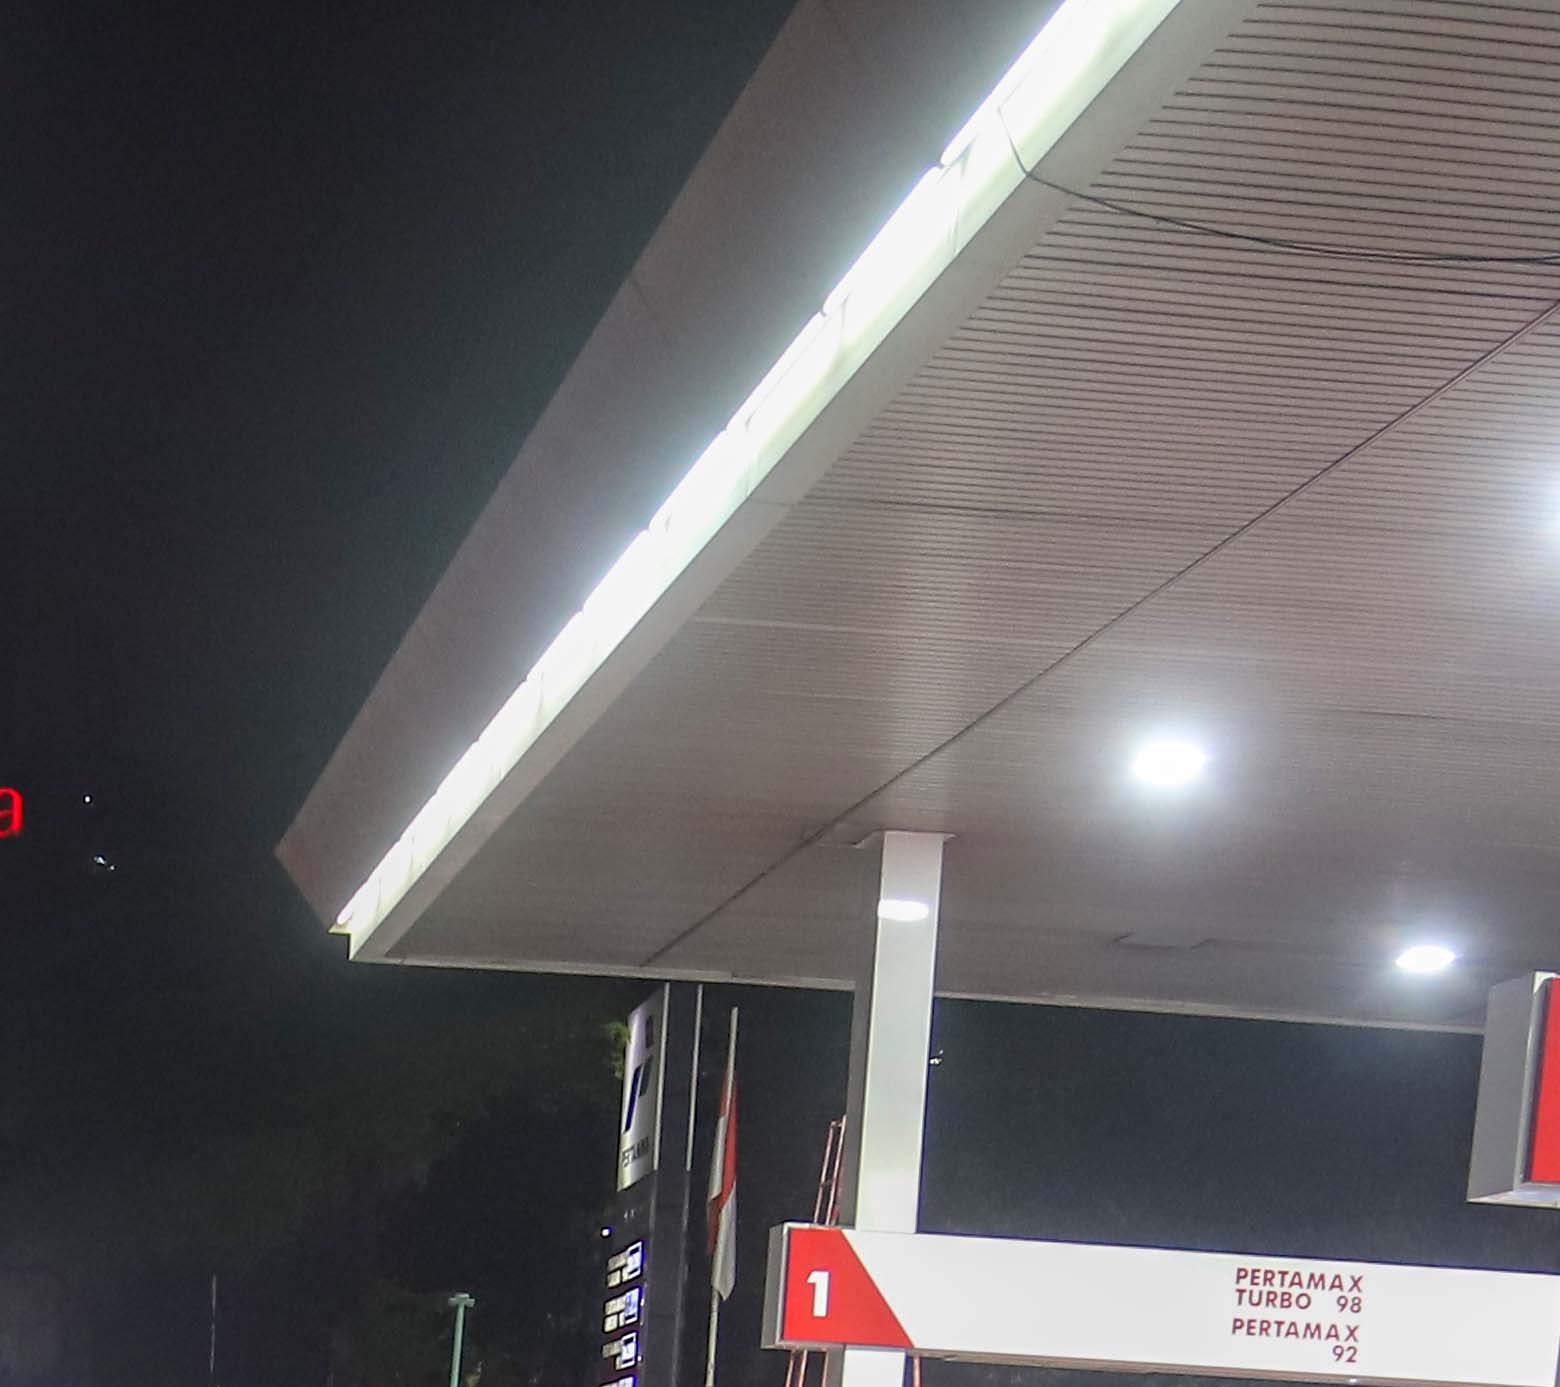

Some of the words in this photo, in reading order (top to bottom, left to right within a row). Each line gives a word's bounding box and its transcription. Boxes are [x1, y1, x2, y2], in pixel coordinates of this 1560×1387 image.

[807, 1271, 829, 1317] 1
[1235, 1268, 1364, 1294] PERTAMAX
[1235, 1288, 1312, 1311] TURBO
[1335, 1294, 1364, 1314] 98
[1232, 1318, 1360, 1343] PERTAMAX
[1331, 1344, 1358, 1364] 92
